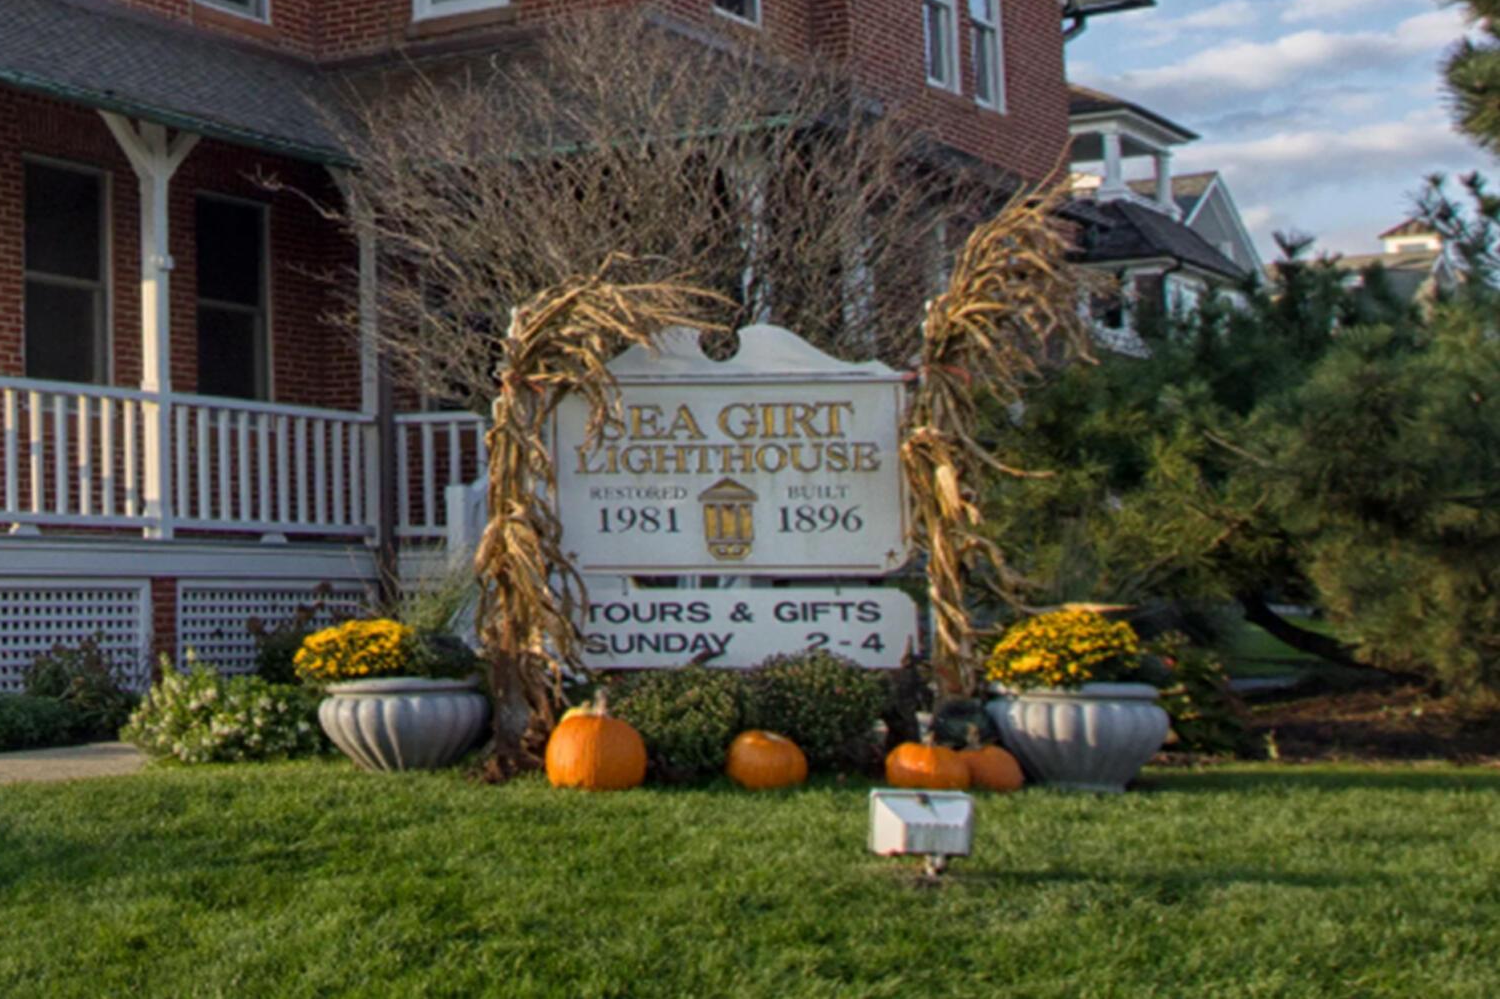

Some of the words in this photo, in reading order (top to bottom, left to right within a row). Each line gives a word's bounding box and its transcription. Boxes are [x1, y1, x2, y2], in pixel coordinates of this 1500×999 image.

[717, 401, 854, 440] GIRT
[574, 442, 881, 474] LIGHTHOUSE
[589, 486, 688, 500] RESTORED
[787, 484, 849, 499] BUILT
[598, 505, 681, 533] 1981
[777, 503, 863, 533] 1896
[729, 601, 754, 623] &
[773, 600, 881, 623] GIFTS
[585, 632, 734, 654] SUNDAY
